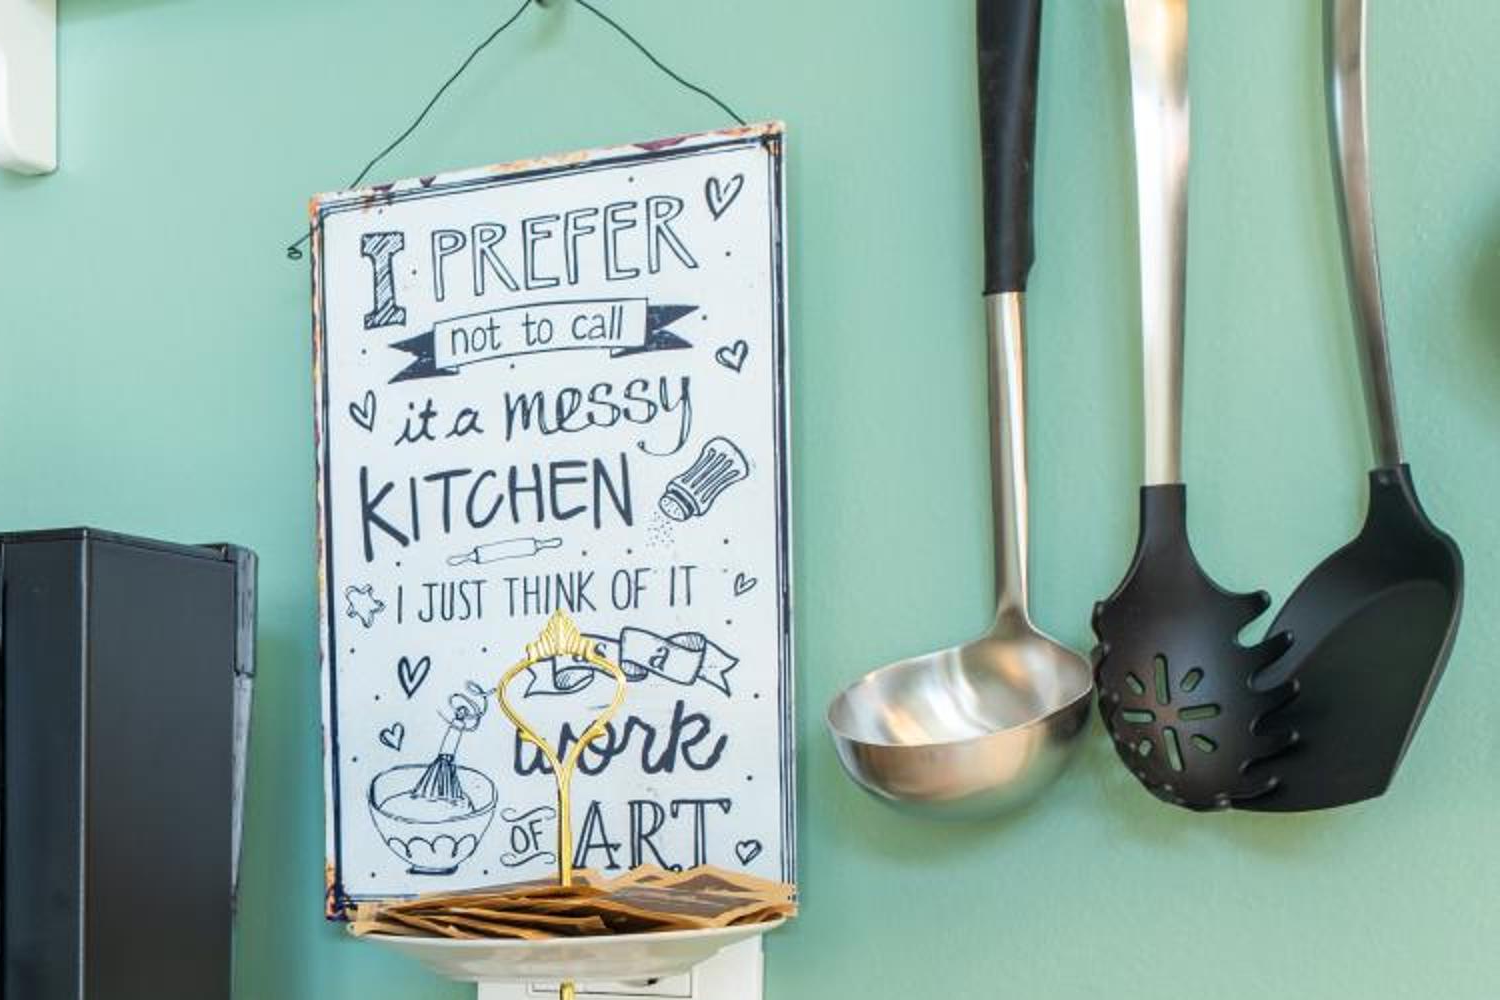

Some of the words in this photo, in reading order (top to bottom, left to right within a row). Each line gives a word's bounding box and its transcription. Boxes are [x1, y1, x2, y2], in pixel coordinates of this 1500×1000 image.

[361, 231, 406, 330] I
[431, 196, 699, 301] PREFER
[451, 320, 501, 357] not
[522, 316, 553, 346] to
[572, 305, 624, 340] call
[503, 375, 692, 457] messy
[360, 452, 634, 562] KITCHEN
[397, 584, 403, 625] I
[418, 579, 487, 623] JUST
[504, 571, 597, 616] THINK
[611, 567, 651, 611] OF
[669, 565, 698, 607] IT
[650, 646, 670, 671] a
[514, 700, 729, 776] work
[510, 819, 545, 854] OF
[573, 798, 732, 873] ART
